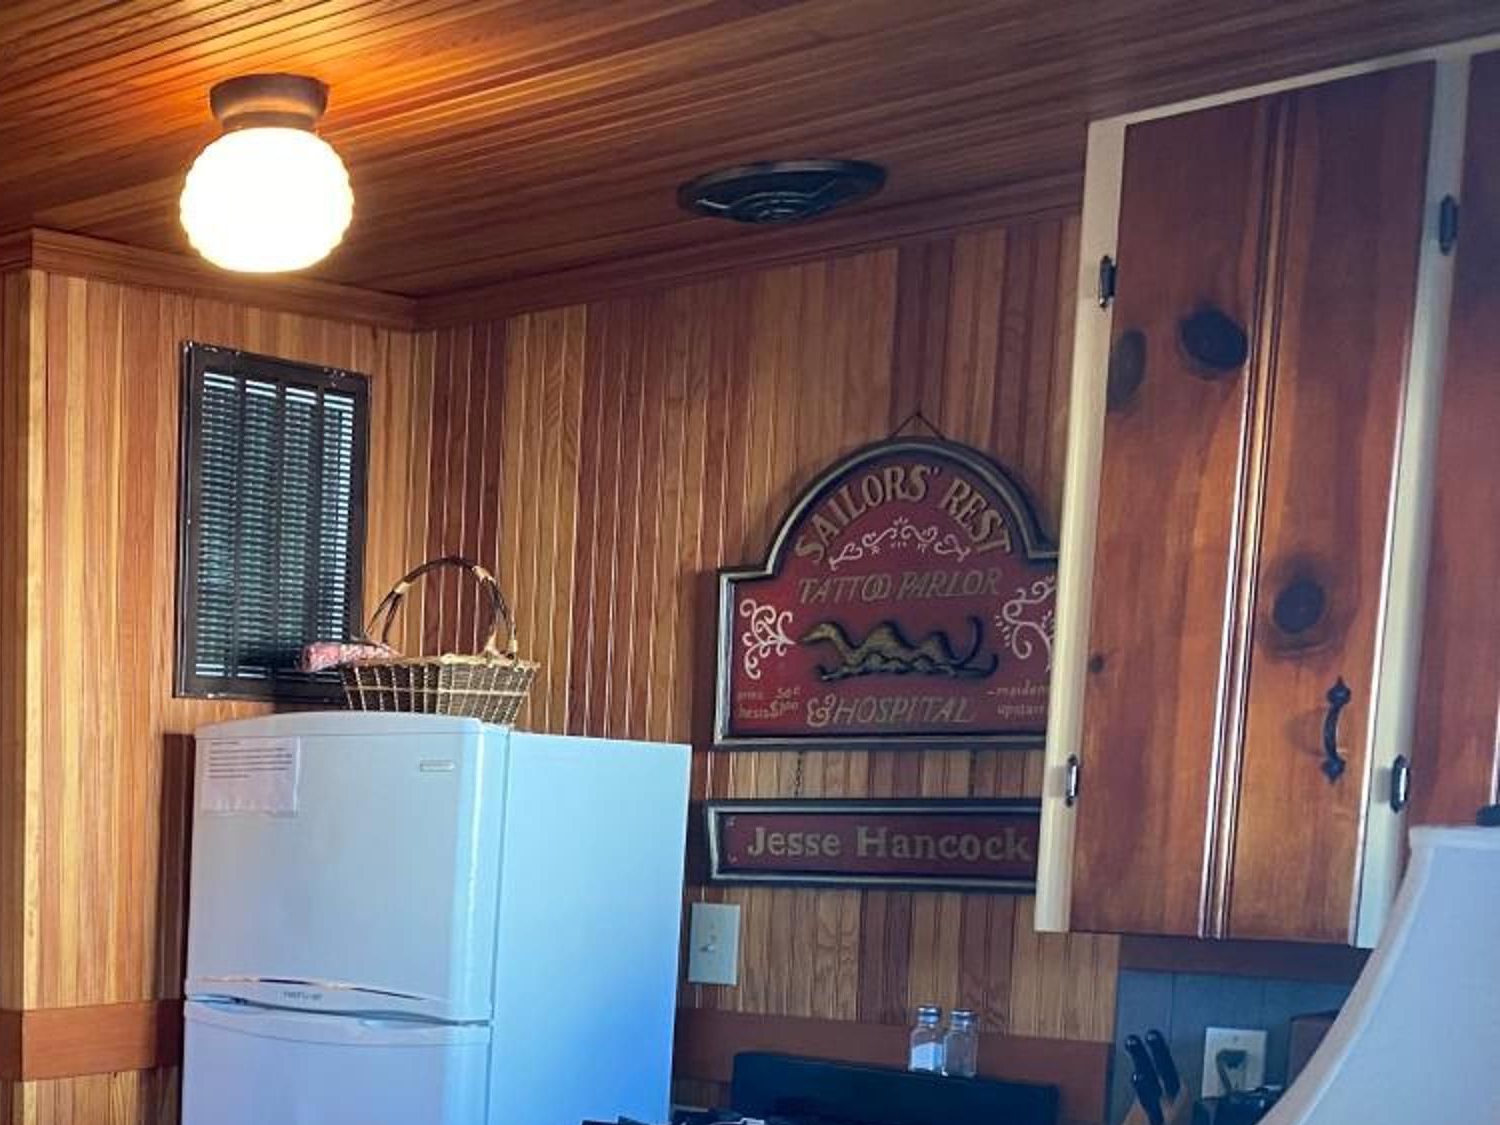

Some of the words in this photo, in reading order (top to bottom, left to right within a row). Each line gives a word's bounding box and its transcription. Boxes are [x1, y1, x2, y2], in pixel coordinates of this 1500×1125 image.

[937, 476, 1012, 553] REST
[799, 572, 891, 604] TATTOO
[895, 569, 1001, 599] PARLOR
[833, 696, 973, 724] HOSPITAL
[747, 826, 841, 857] Jesse
[854, 824, 1034, 863] Hancock
